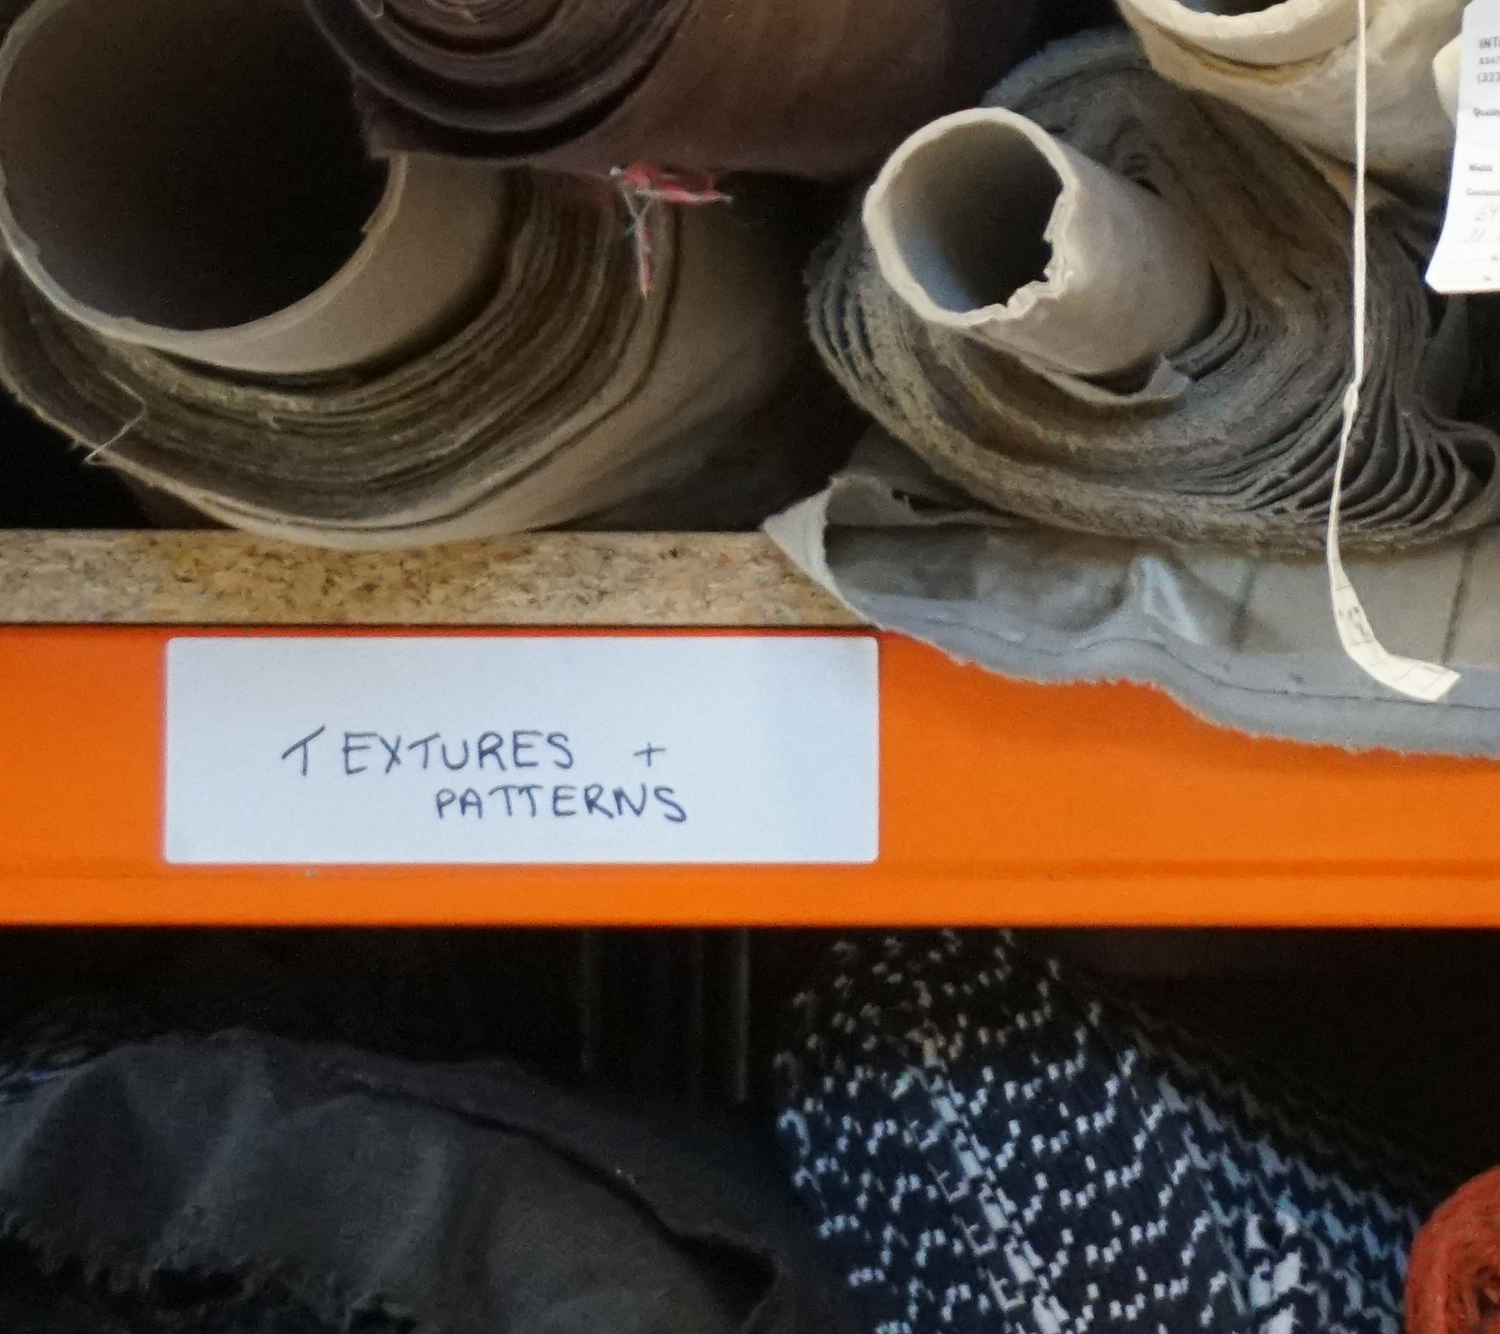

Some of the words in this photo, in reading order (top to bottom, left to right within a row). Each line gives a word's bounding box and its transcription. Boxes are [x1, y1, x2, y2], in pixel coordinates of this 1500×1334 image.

[282, 725, 577, 778] TEXTURES
[633, 741, 667, 768] +
[434, 783, 688, 823] PATTERNS
